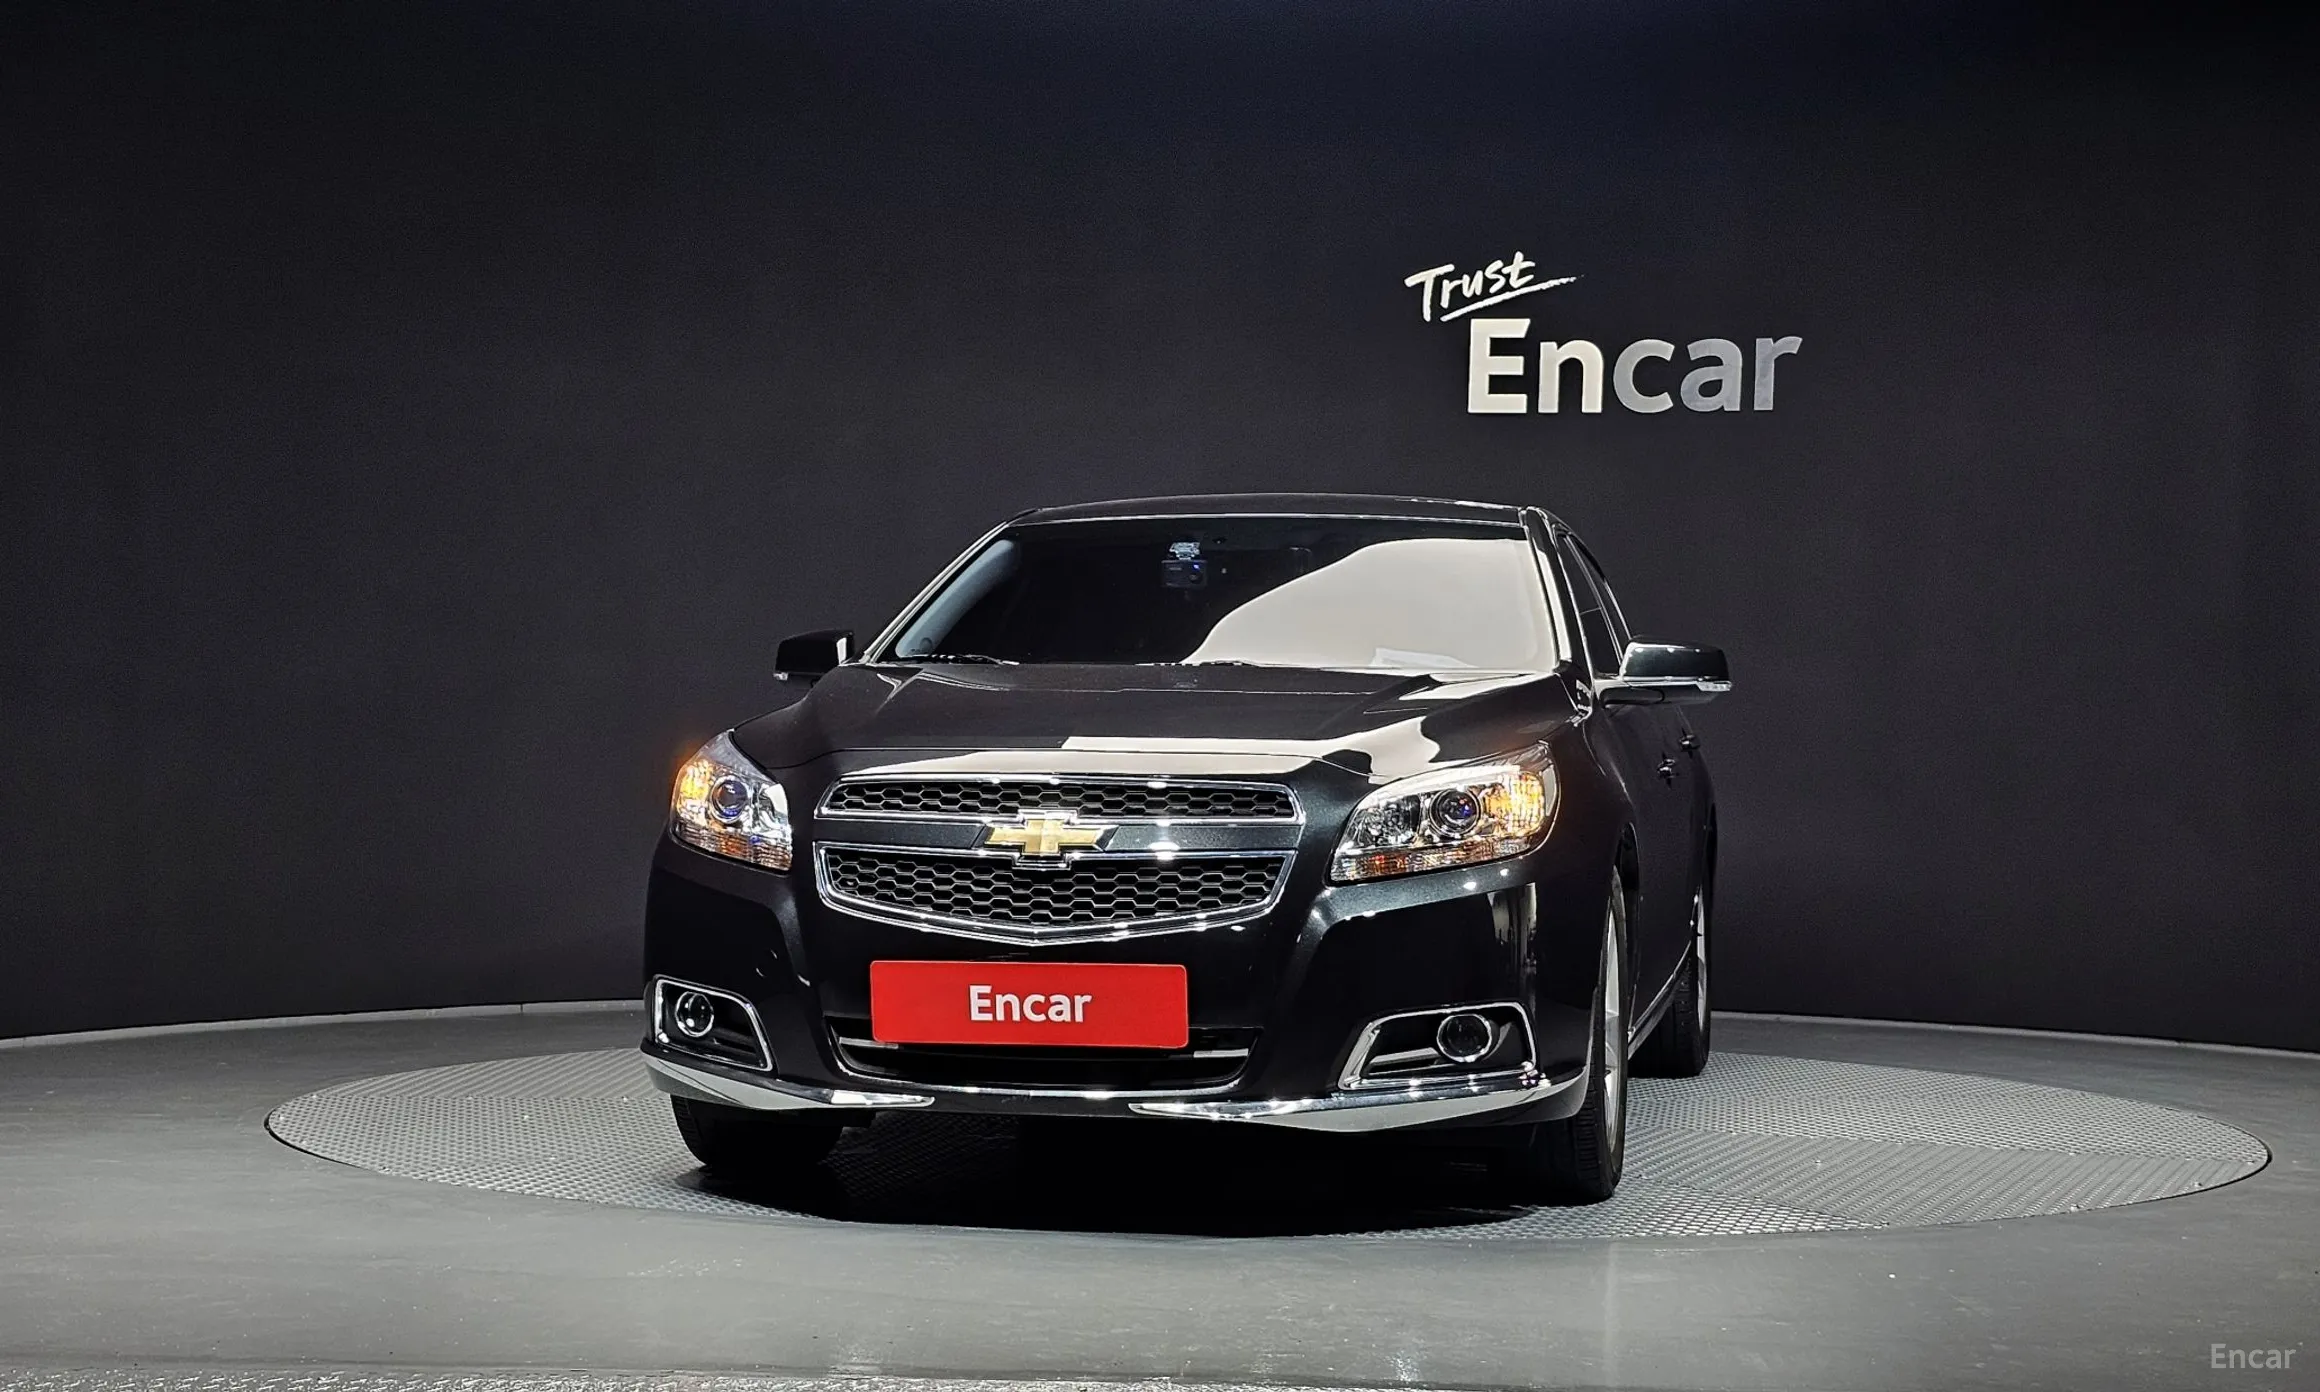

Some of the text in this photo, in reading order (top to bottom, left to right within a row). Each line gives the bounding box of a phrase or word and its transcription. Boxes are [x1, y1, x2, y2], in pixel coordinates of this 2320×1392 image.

[1404, 251, 1537, 322] Trust
[1468, 318, 1803, 414] Encar
[969, 985, 1092, 1023] Encar
